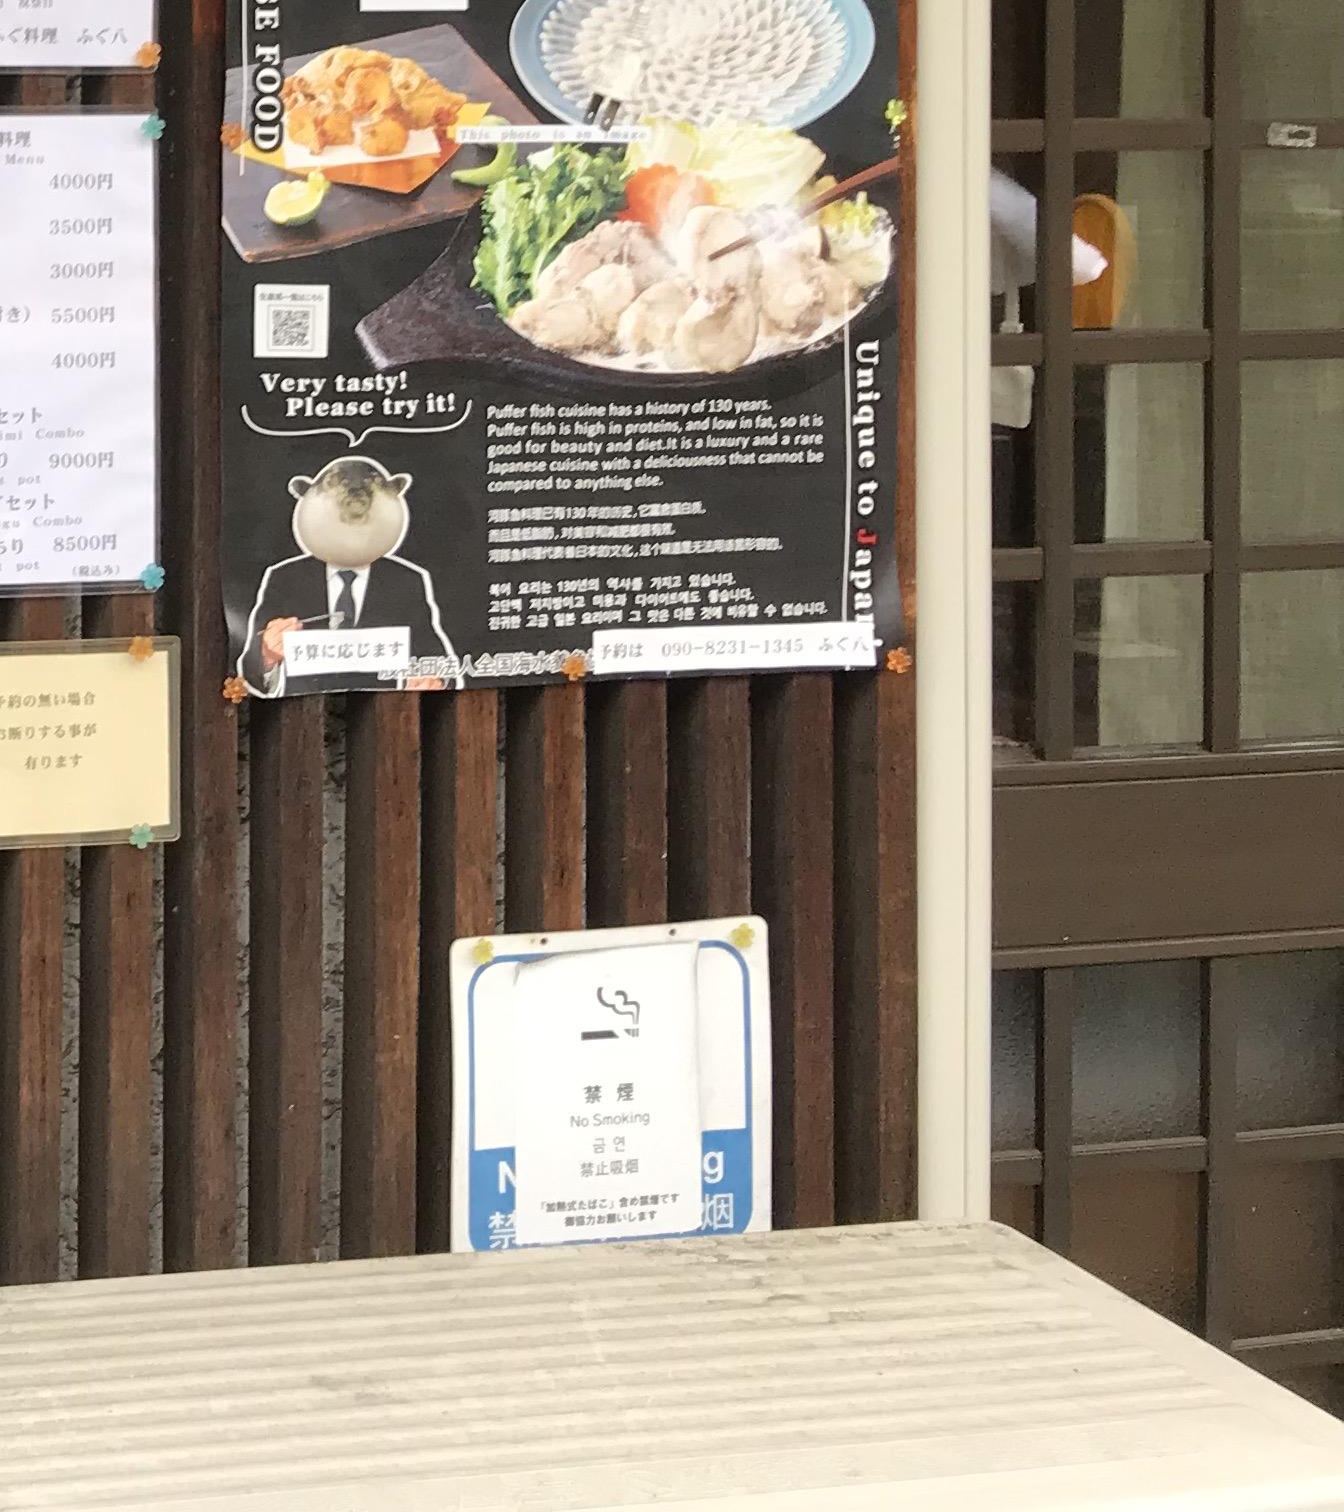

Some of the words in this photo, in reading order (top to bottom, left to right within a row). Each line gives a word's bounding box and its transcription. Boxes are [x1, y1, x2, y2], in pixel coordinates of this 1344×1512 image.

[255, 43, 282, 150] FOOD
[5, 154, 45, 165] Menu
[49, 173, 113, 190] 4000円
[49, 218, 113, 236] 3500円
[50, 261, 114, 279] 3000円
[51, 306, 115, 323] 5500円
[52, 351, 116, 369] 4000円
[260, 373, 326, 397] Very
[335, 371, 408, 395] tasty!
[285, 397, 374, 417] Please
[382, 397, 420, 419] try
[426, 392, 455, 413] it!
[487, 403, 527, 419] Puffer
[530, 403, 555, 418] fish
[558, 402, 606, 418] cuisine
[609, 402, 633, 416] has
[645, 400, 690, 416] history
[708, 399, 733, 413] 130
[853, 339, 881, 469] Unique
[487, 422, 528, 437] Puffer
[531, 422, 556, 436] fish
[574, 421, 605, 438] high
[712, 416, 737, 430] low
[487, 440, 522, 458] good
[525, 439, 547, 454] for
[551, 439, 603, 455] beauty
[606, 438, 632, 452] and
[706, 434, 750, 449] luxury
[794, 434, 824, 445] rare
[49, 451, 114, 469] 9000円
[487, 461, 547, 475] Japanese
[549, 458, 598, 472] cuisine
[758, 451, 804, 464] cannot
[807, 449, 824, 463] be
[487, 476, 553, 493] compared
[556, 477, 572, 489] to
[574, 475, 632, 492] anything
[857, 479, 879, 516] to
[33, 515, 83, 528] Combo
[53, 534, 117, 552] 8500円
[662, 639, 803, 657] 090-8231-1345
[25, 754, 82, 770] 有ります
[584, 1082, 634, 1103] 禁煙
[570, 1115, 589, 1128] No
[593, 1111, 650, 1126] Smoking
[593, 1136, 626, 1152] 금연
[580, 1159, 639, 1177] 禁止吸烟
